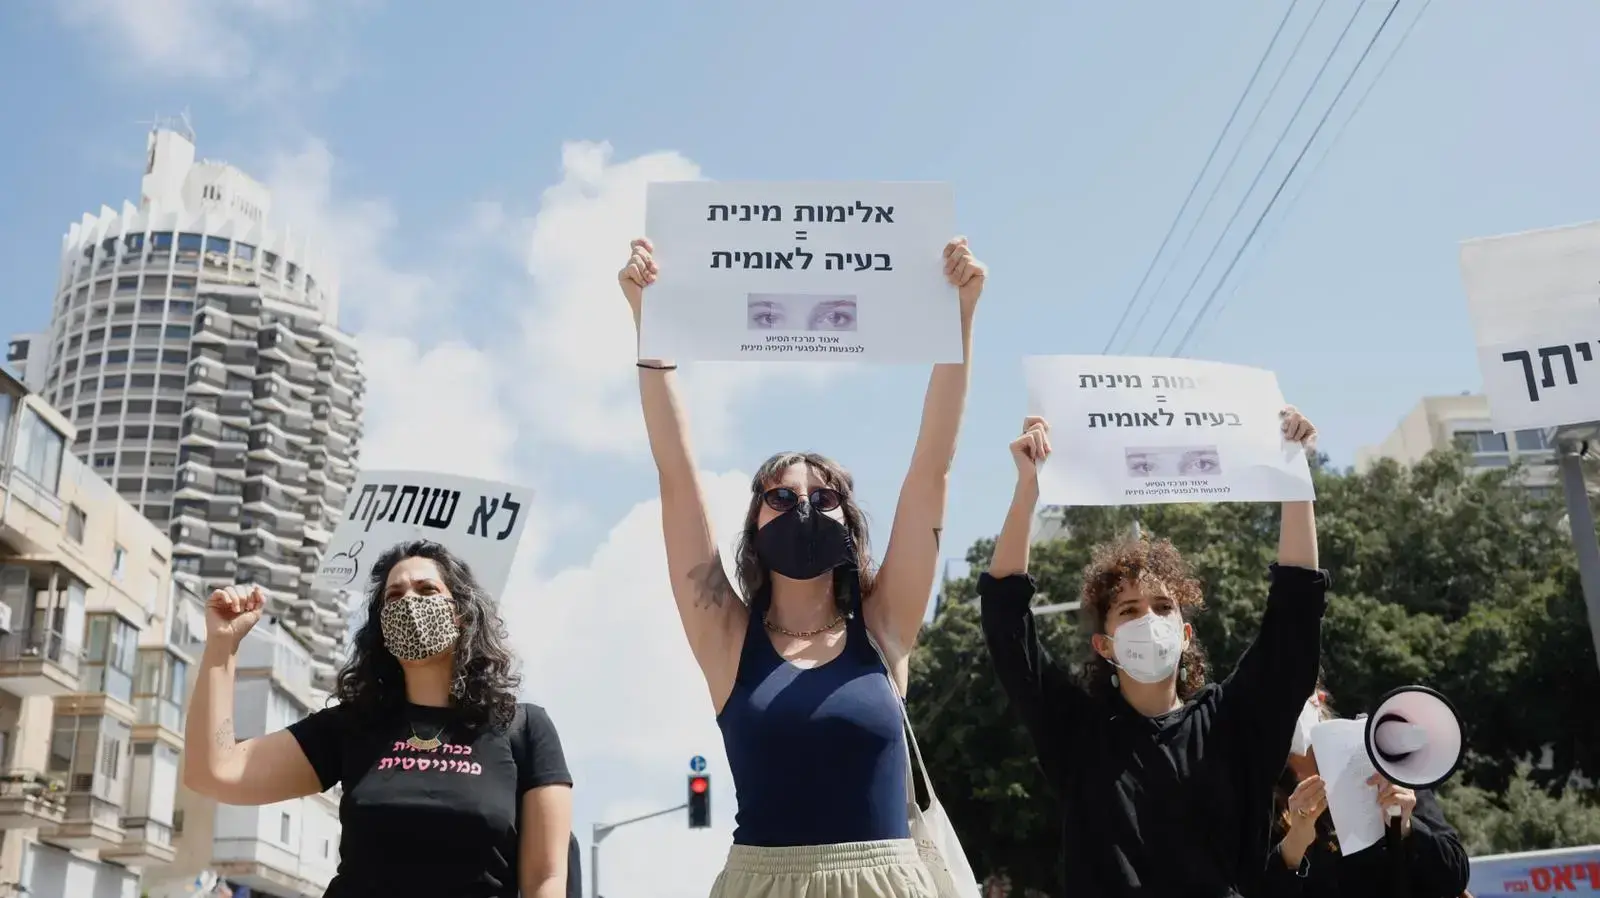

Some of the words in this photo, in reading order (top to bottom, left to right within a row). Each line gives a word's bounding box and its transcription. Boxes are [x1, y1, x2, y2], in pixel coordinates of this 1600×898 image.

[706, 203, 782, 222] מינית
[793, 200, 895, 224] אלימות
[710, 246, 814, 271] לאומית
[825, 252, 893, 272] בעיה
[740, 343, 763, 352] מינית
[765, 335, 790, 343] הסיוע
[790, 335, 816, 343] מרכזי
[817, 336, 840, 344] איגוד
[764, 344, 794, 353] תקיפה
[794, 344, 827, 353] ולנפגעי
[828, 344, 865, 354] לנפגעות
[1501, 339, 1600, 402] יתך
[1078, 373, 1143, 389] מינית
[1088, 407, 1175, 429] לאומית
[1184, 411, 1243, 428] בעיה
[348, 483, 461, 533] שותקת
[466, 492, 521, 541] לא
[442, 743, 473, 755] ככה
[378, 756, 482, 776] פמיניסטית
